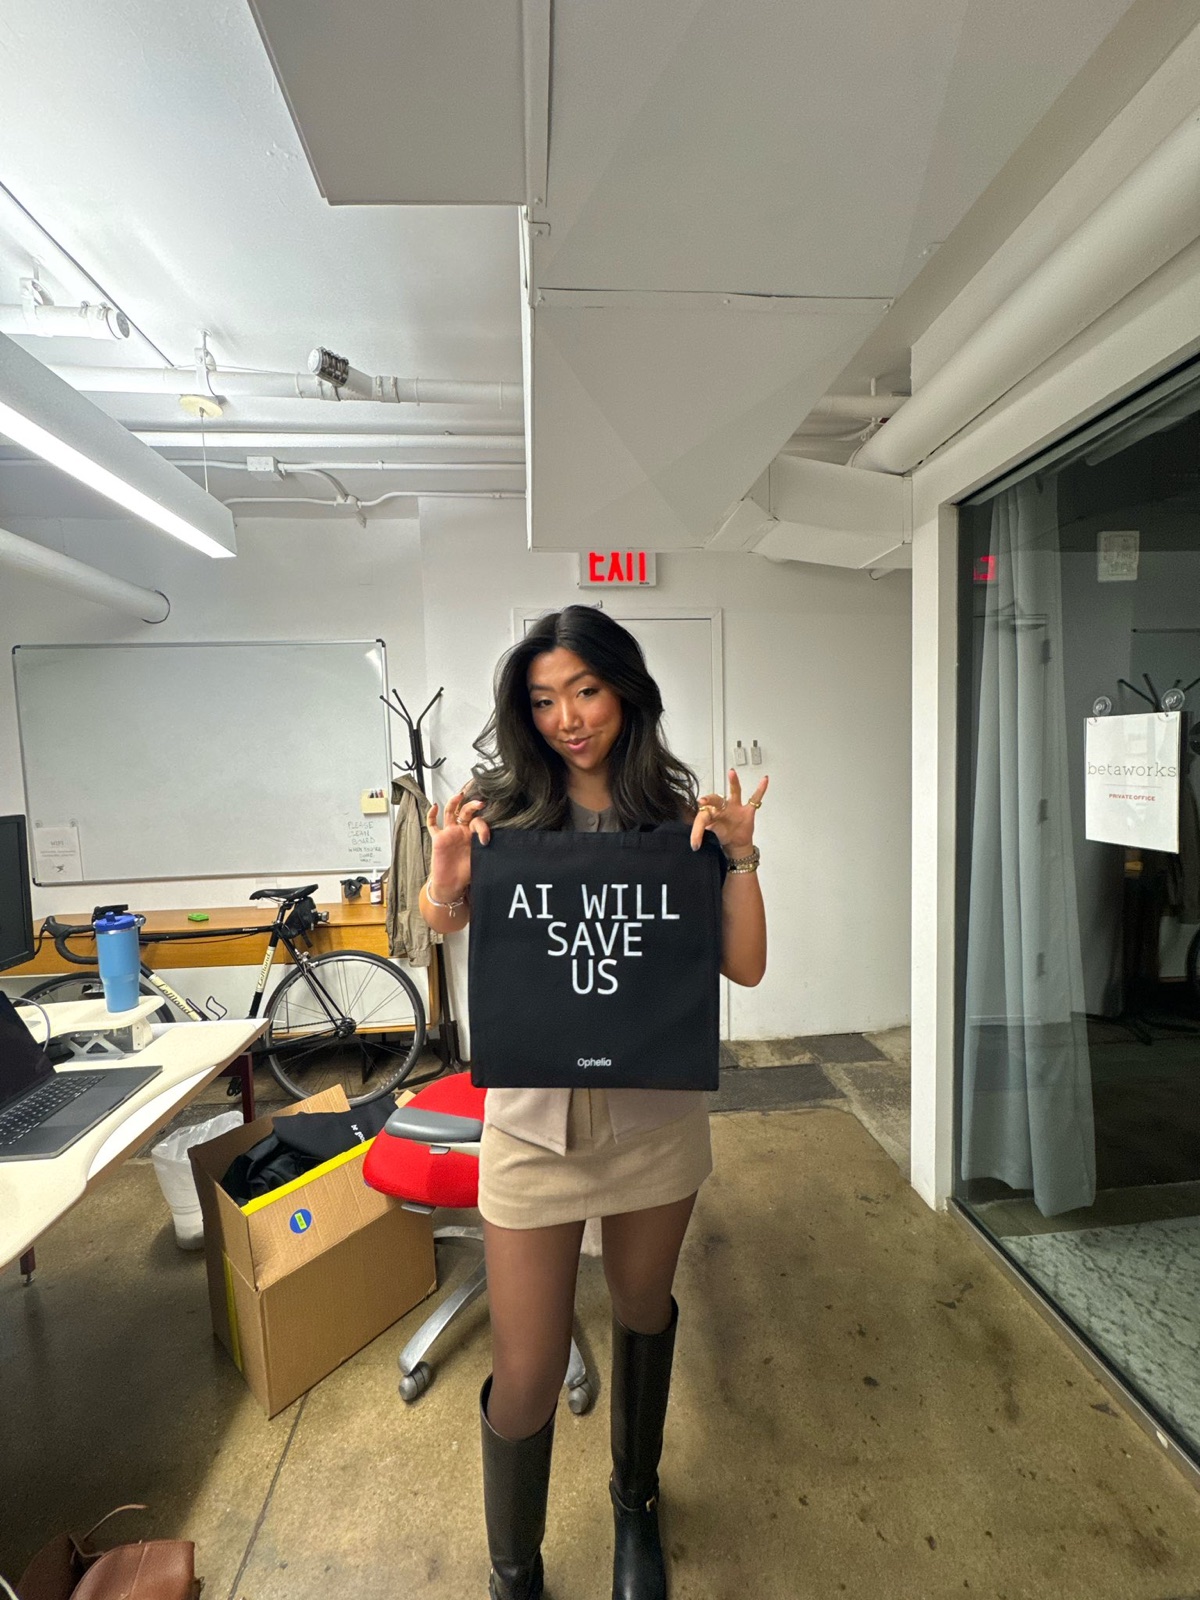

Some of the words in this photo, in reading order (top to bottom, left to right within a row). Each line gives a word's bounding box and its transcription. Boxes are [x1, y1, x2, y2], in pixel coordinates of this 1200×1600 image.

[1087, 761, 1177, 778] betaworks
[347, 820, 374, 830] PLEASE
[351, 836, 376, 845] BOARD
[508, 883, 554, 919] AI
[581, 883, 680, 920] WILL
[547, 921, 643, 957] SAVE
[571, 958, 619, 995] US
[577, 1057, 612, 1069] Ophelia
